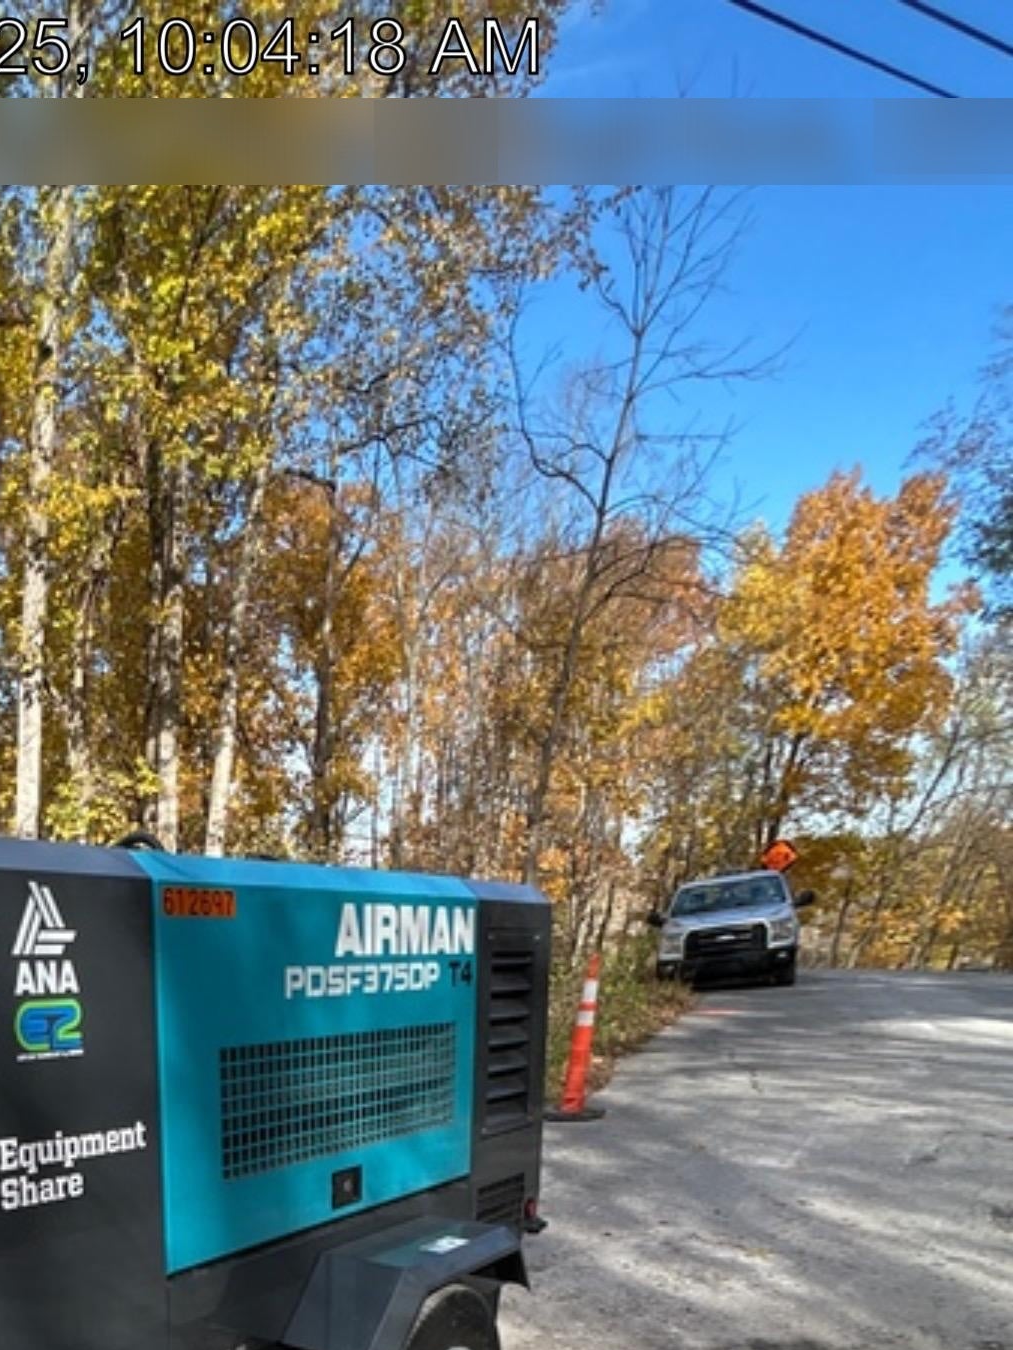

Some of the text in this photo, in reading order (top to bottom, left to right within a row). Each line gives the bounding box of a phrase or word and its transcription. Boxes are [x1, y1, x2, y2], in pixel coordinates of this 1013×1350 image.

[335, 902, 476, 957] AIRMAN
[14, 959, 80, 996] ANA
[285, 960, 473, 1000] PDSF375DP T4
[0, 1171, 85, 1211] Share
